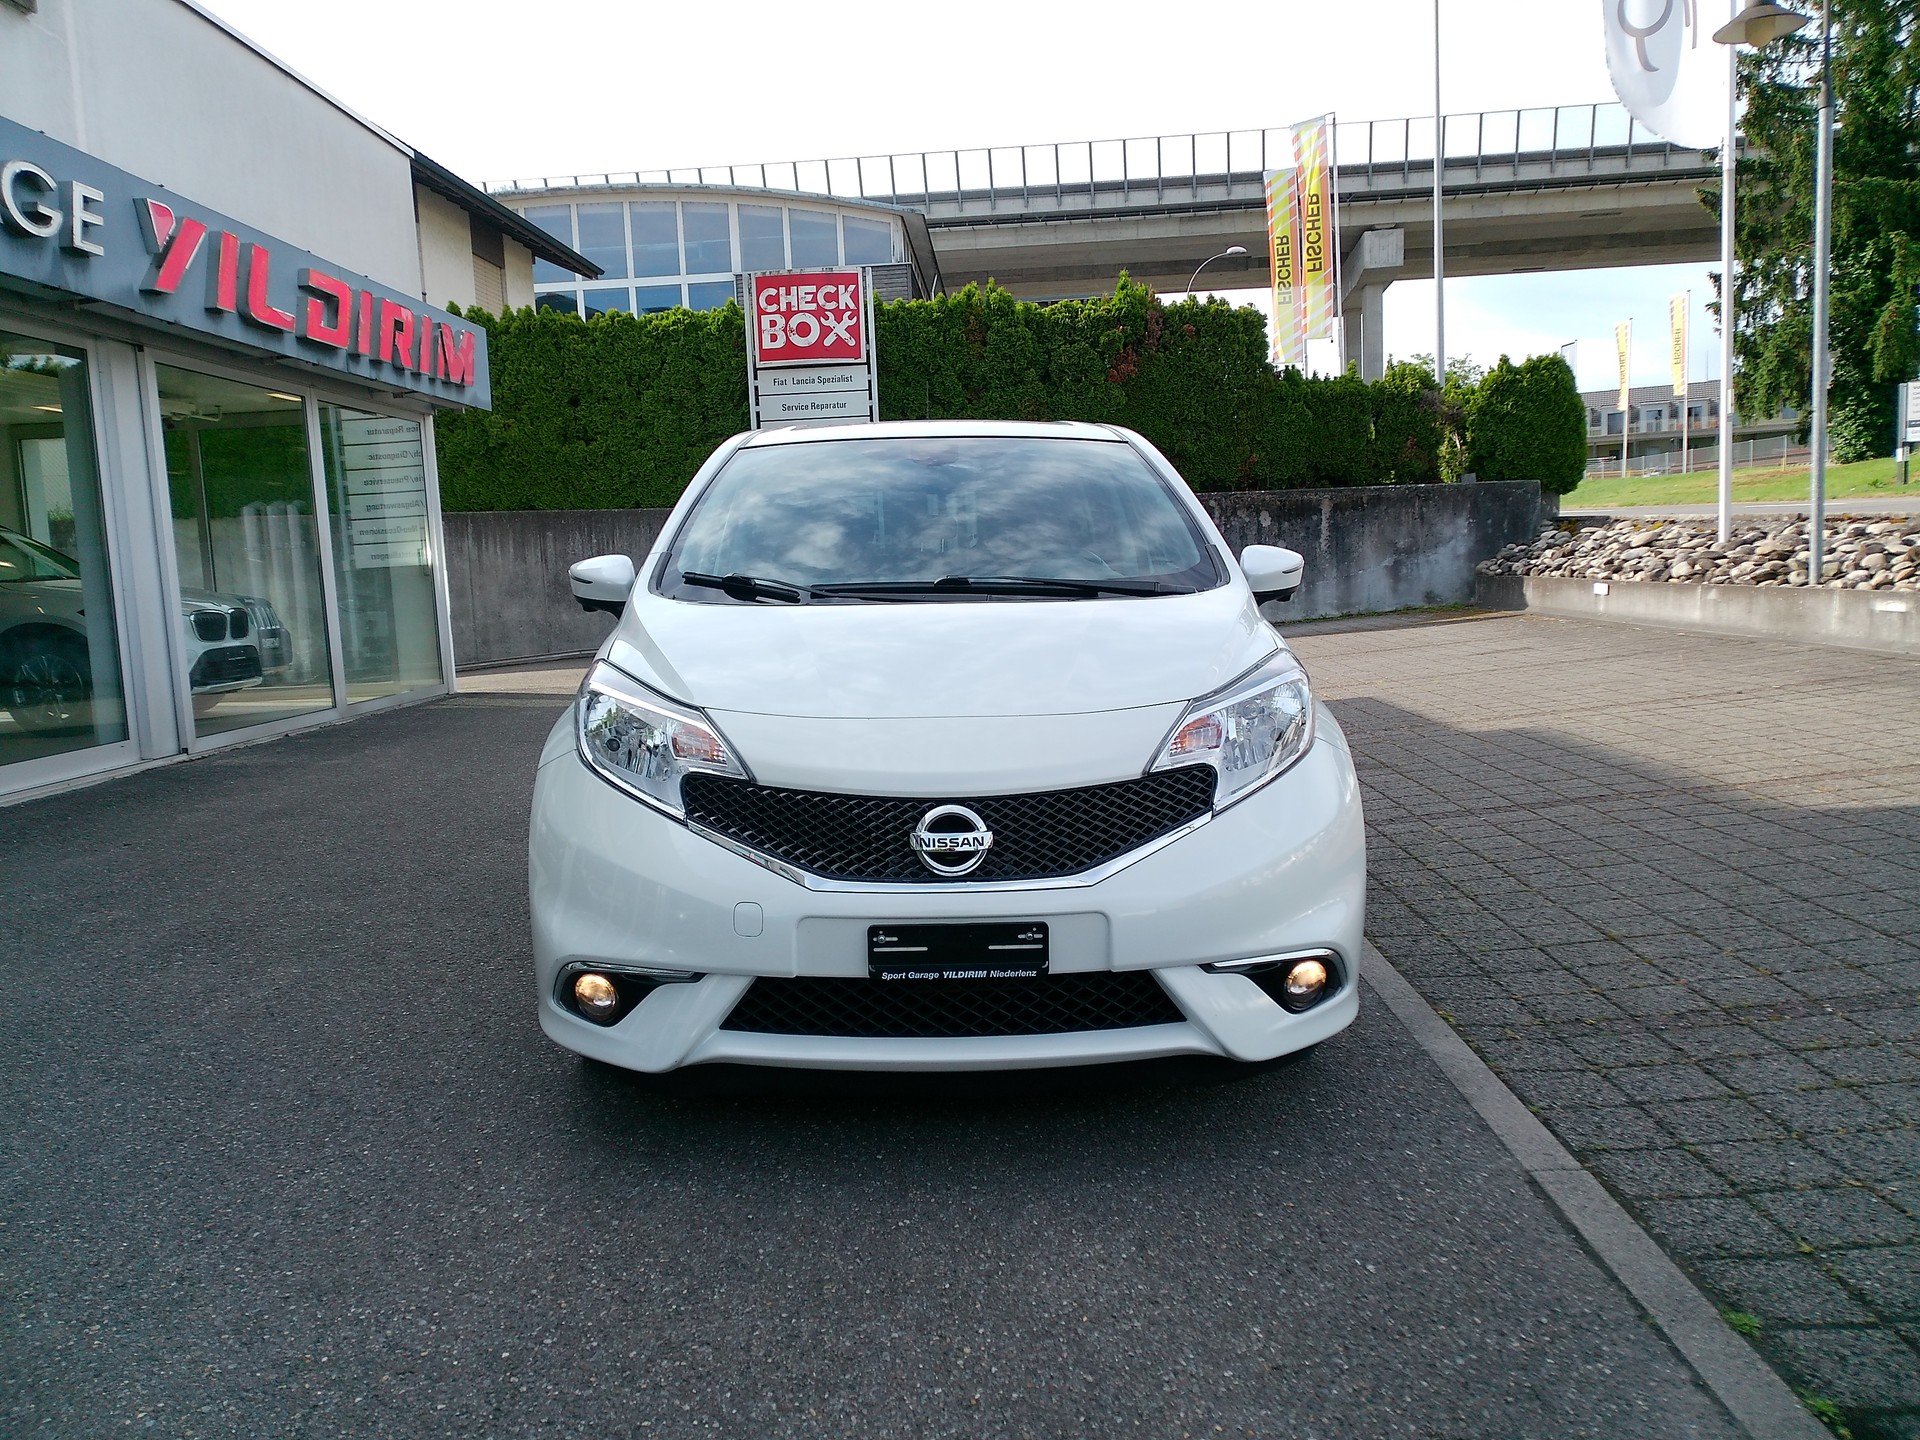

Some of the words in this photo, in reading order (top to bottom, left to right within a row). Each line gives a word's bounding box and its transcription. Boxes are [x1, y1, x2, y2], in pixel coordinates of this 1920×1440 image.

[0, 160, 104, 257] GE
[134, 197, 475, 388] YILDIRIM
[759, 285, 857, 313] CHECK
[760, 311, 858, 350] BOX
[773, 378, 788, 387] Fiat
[792, 376, 816, 386] Lancia
[817, 374, 854, 385] Spezialist
[781, 402, 809, 412] Service
[811, 401, 847, 411] Reparatur
[919, 836, 985, 849] NISSAN
[881, 971, 906, 981] Sport
[908, 971, 940, 981] Garage
[942, 970, 987, 979] YILDIRIM
[989, 969, 1037, 979] Niederlenz
